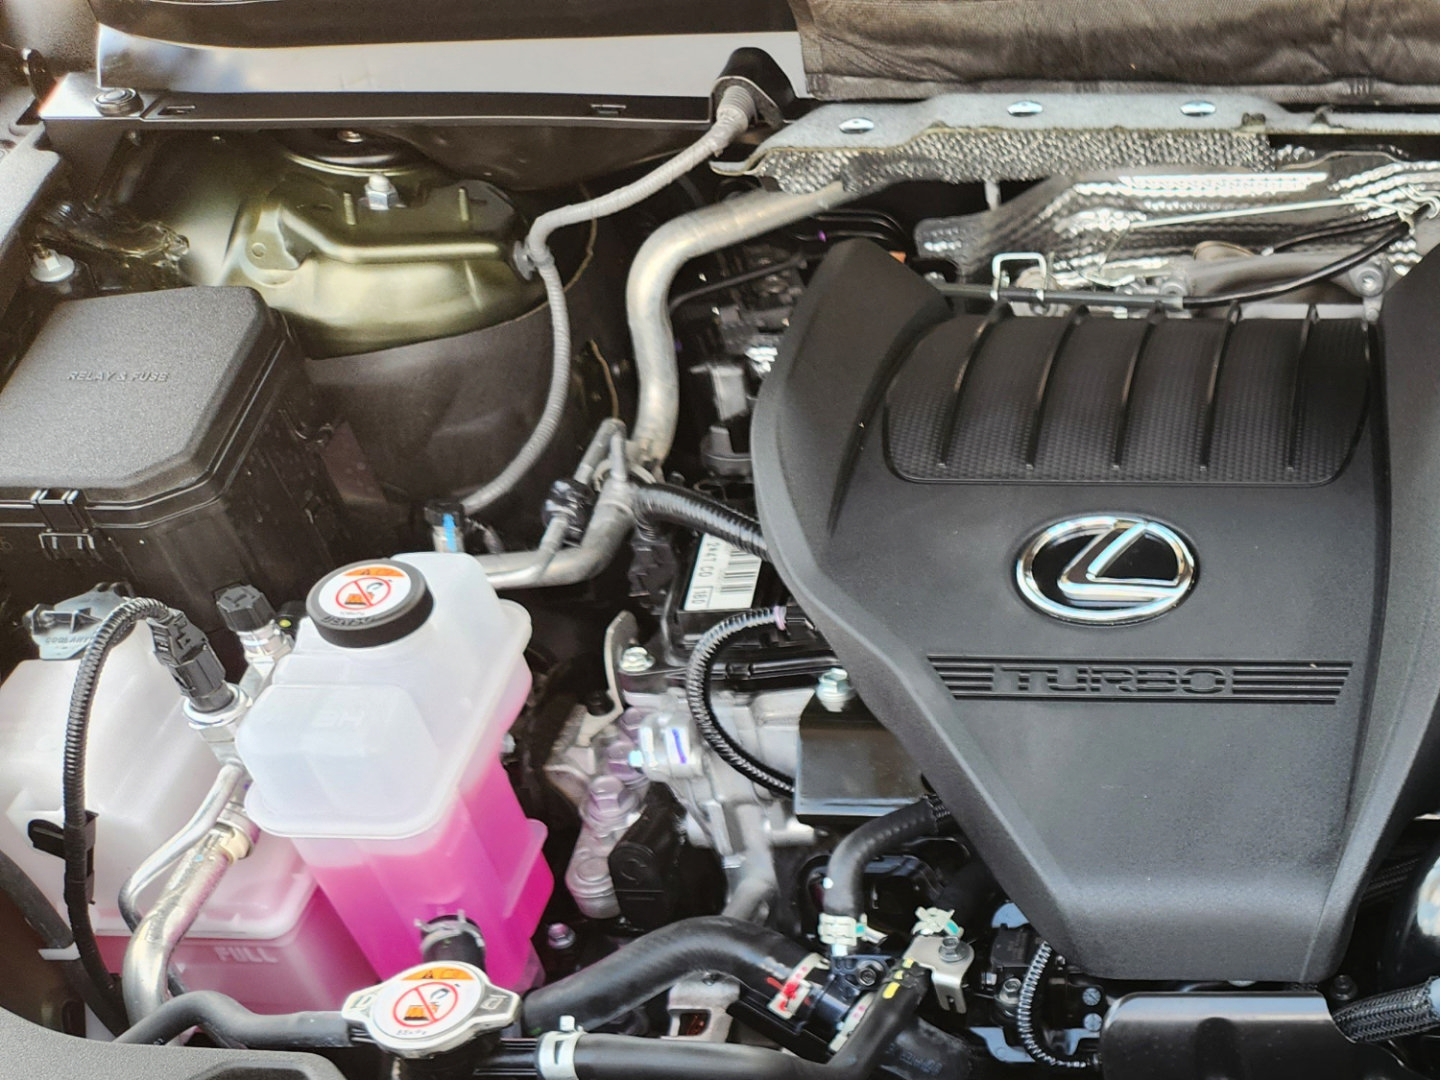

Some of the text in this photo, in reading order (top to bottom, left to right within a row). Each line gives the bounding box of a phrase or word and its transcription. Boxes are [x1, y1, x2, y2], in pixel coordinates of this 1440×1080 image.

[67, 371, 116, 381] RELAY
[132, 371, 169, 382] FUSE
[1001, 667, 1226, 694] TURBO
[213, 946, 279, 963] FULL
